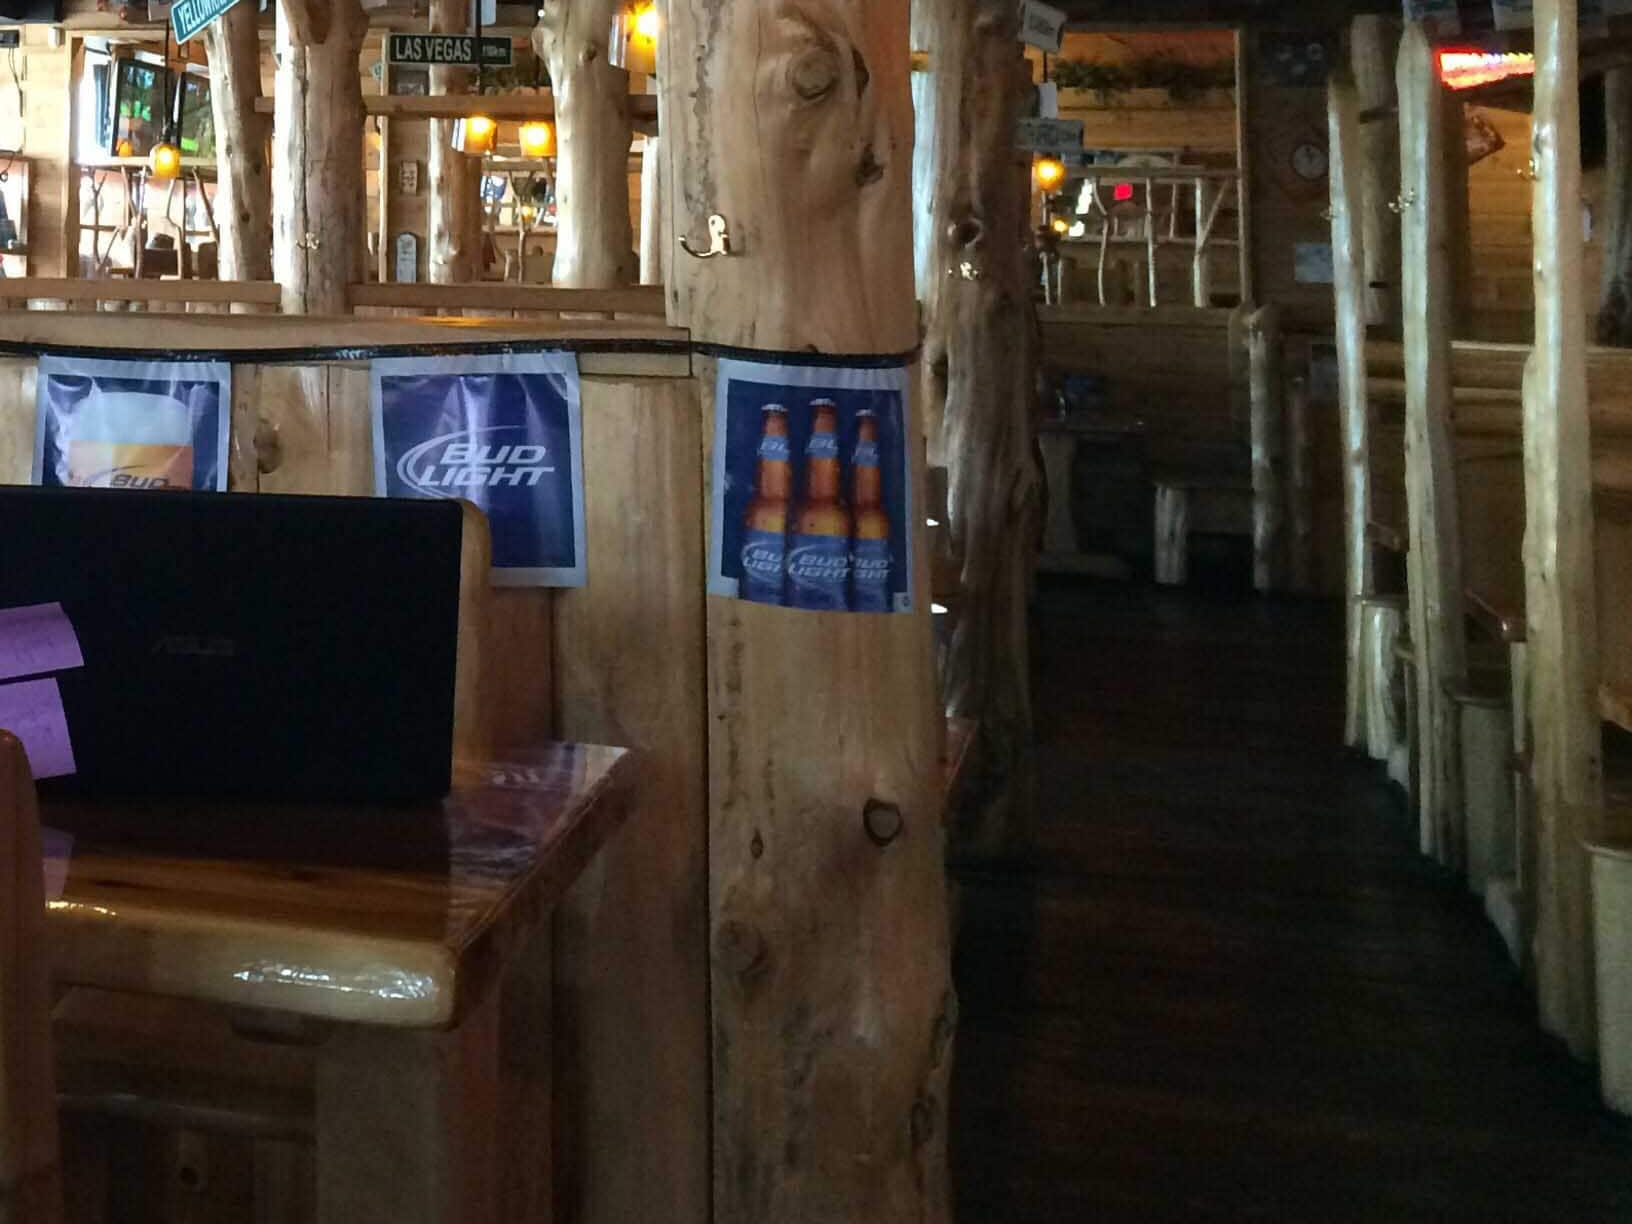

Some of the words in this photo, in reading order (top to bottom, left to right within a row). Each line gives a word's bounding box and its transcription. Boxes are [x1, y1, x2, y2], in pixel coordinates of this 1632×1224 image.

[395, 37, 423, 61] LAS
[425, 38, 472, 61] VEGAS
[440, 443, 546, 465] BUD
[418, 465, 555, 486] LIGHT
[788, 562, 852, 577] LIGHT
[798, 554, 848, 568] BUD
